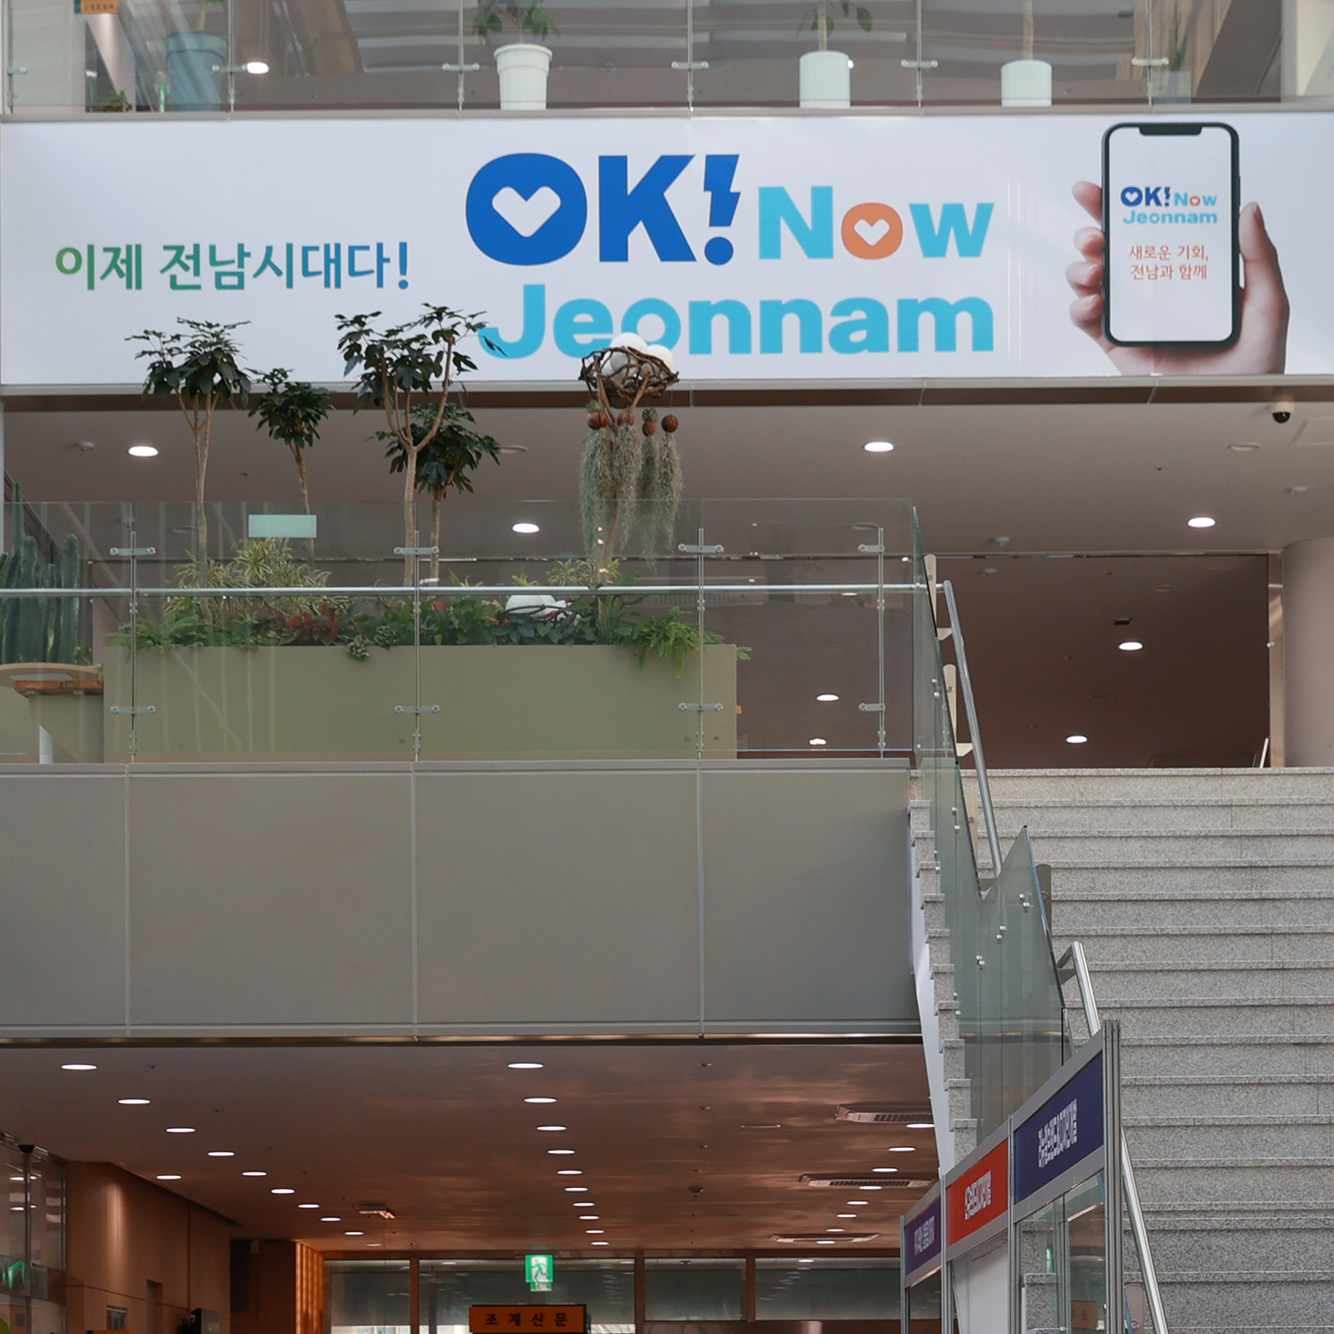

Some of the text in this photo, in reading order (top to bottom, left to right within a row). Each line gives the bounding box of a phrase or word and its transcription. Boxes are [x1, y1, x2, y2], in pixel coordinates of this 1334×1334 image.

[1120, 186, 1218, 208] OK! Now
[465, 152, 995, 267] OK! Now
[1122, 210, 1218, 225] Jeonnam
[1129, 245, 1209, 262] 새로운 기회,
[54, 240, 410, 292] 이제 전남시대다!
[1131, 264, 1208, 281] 전남과 함께
[478, 283, 995, 360] Jeonnam
